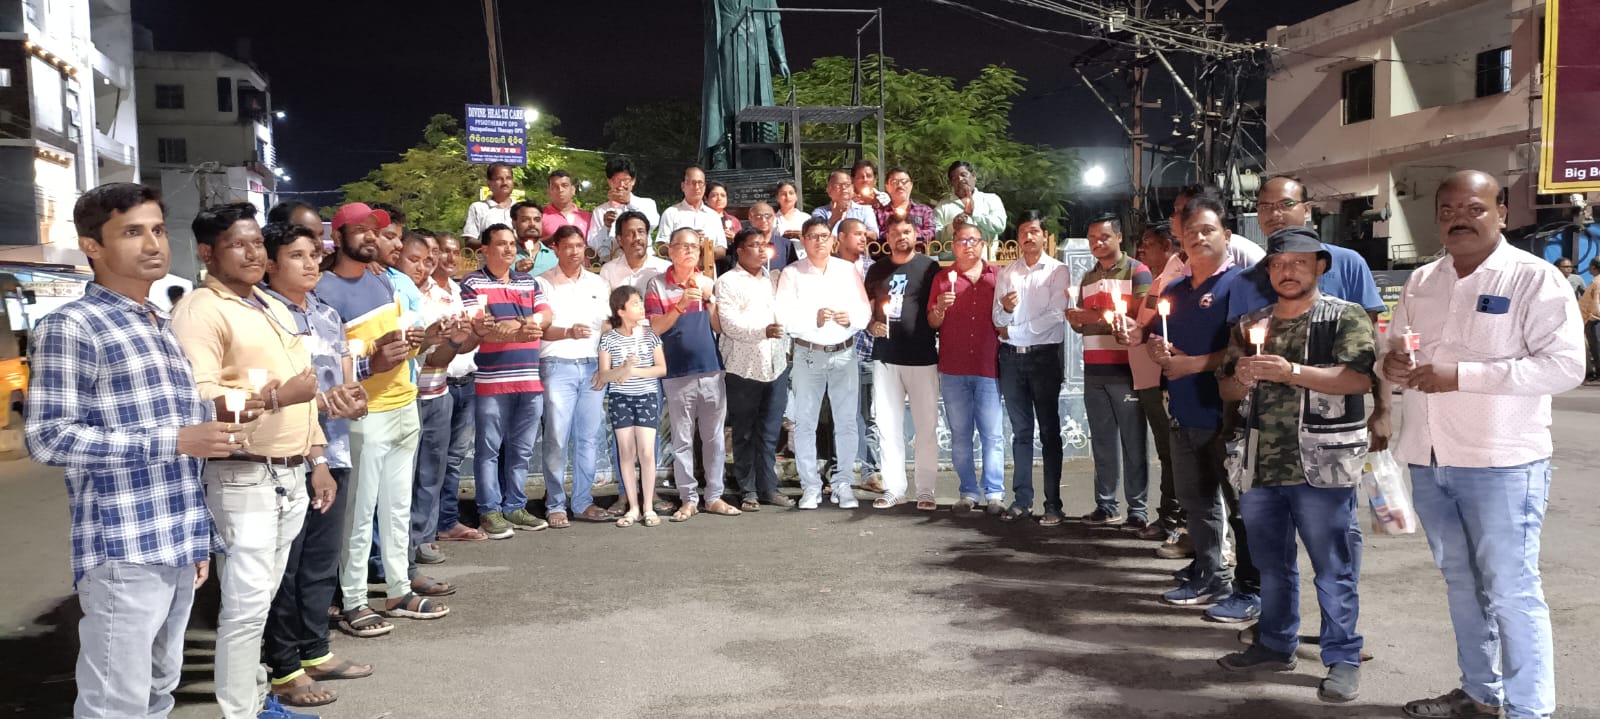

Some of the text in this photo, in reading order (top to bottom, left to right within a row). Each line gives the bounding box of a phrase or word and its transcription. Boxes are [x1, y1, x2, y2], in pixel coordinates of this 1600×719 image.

[468, 107, 524, 119] DIVINE HEALTH CARE
[1565, 168, 1586, 180] Big
